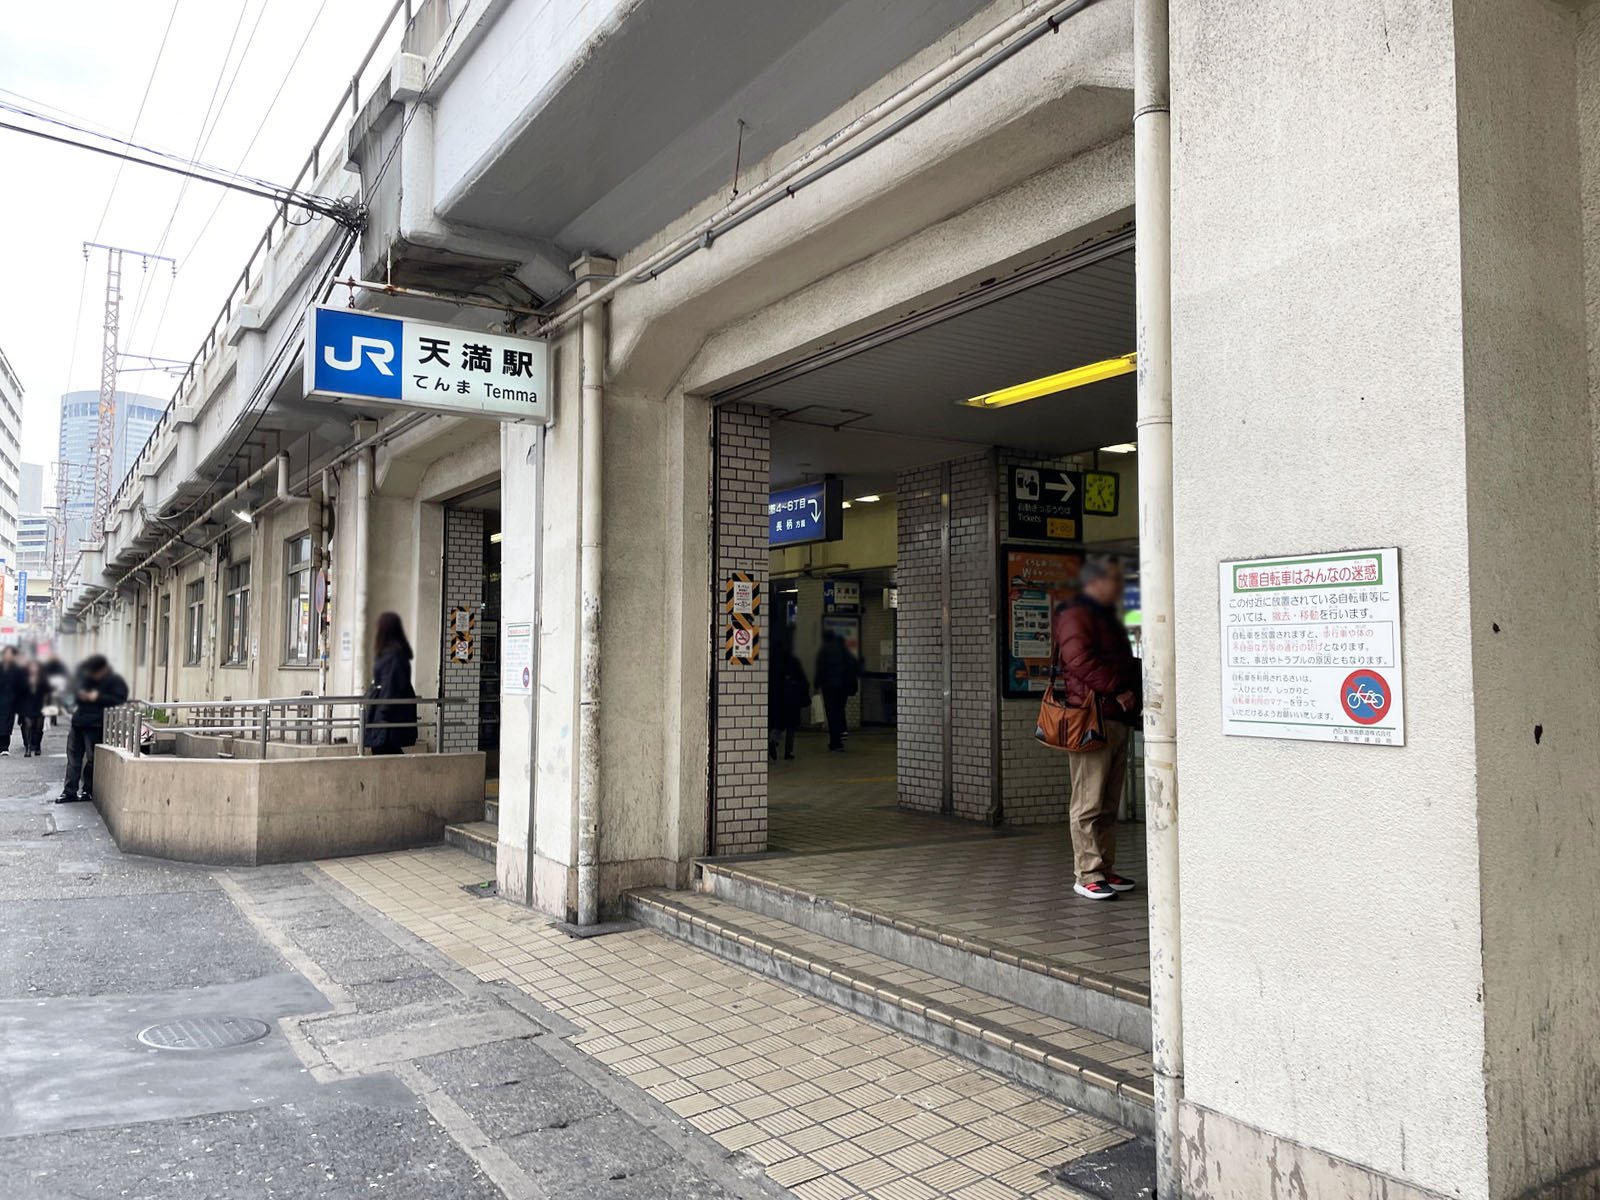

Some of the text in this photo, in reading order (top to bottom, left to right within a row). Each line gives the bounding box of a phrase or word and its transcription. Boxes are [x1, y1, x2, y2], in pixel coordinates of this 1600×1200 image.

[324, 335, 394, 376] JR
[418, 336, 534, 379] 天満駅
[413, 374, 538, 404] てんま Temma
[1237, 563, 1377, 589] 放置自転車はみんなの迷惑
